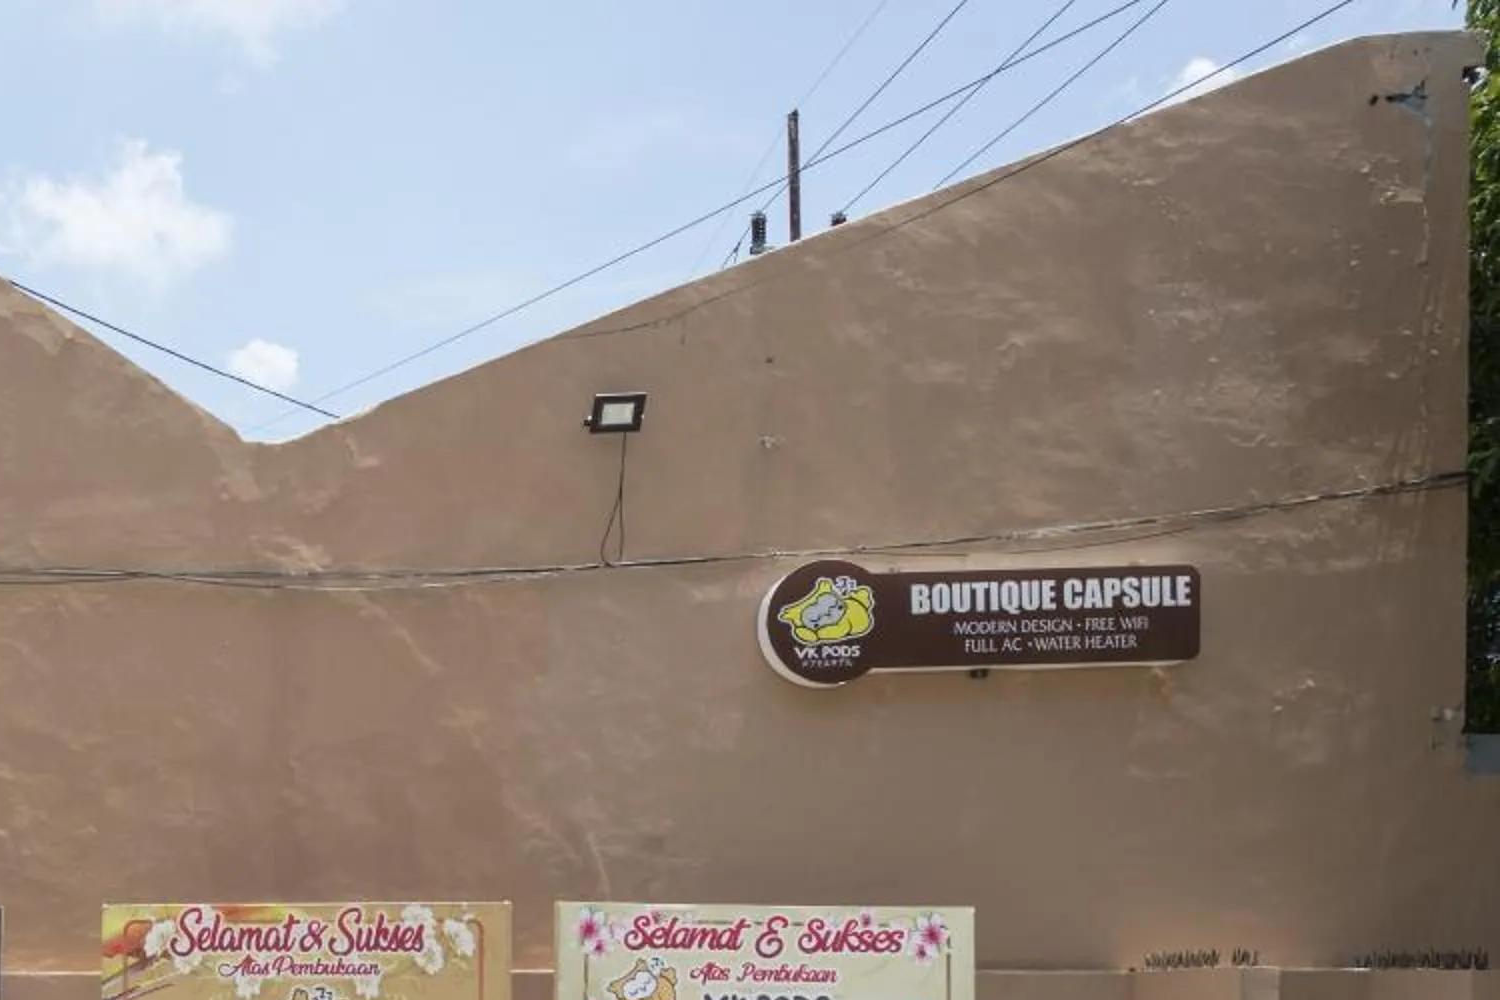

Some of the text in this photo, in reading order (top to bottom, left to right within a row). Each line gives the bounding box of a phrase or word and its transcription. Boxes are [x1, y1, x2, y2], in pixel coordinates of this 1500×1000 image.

[911, 576, 1191, 614] BOUTIQUE CAPSULE
[954, 620, 1017, 635] MODERN
[1021, 618, 1072, 633] DESIGN
[1085, 617, 1115, 631] FREE
[794, 646, 860, 658] VK PODS
[965, 636, 1137, 652] FULL AC WATER HEATER
[170, 908, 424, 956] Selamat & Sukses
[624, 915, 750, 950] Selamat
[798, 918, 904, 953] Sukses
[219, 955, 380, 977] Atas Pembukaan
[690, 962, 730, 984] Atas
[737, 963, 837, 983] Pembukaan
